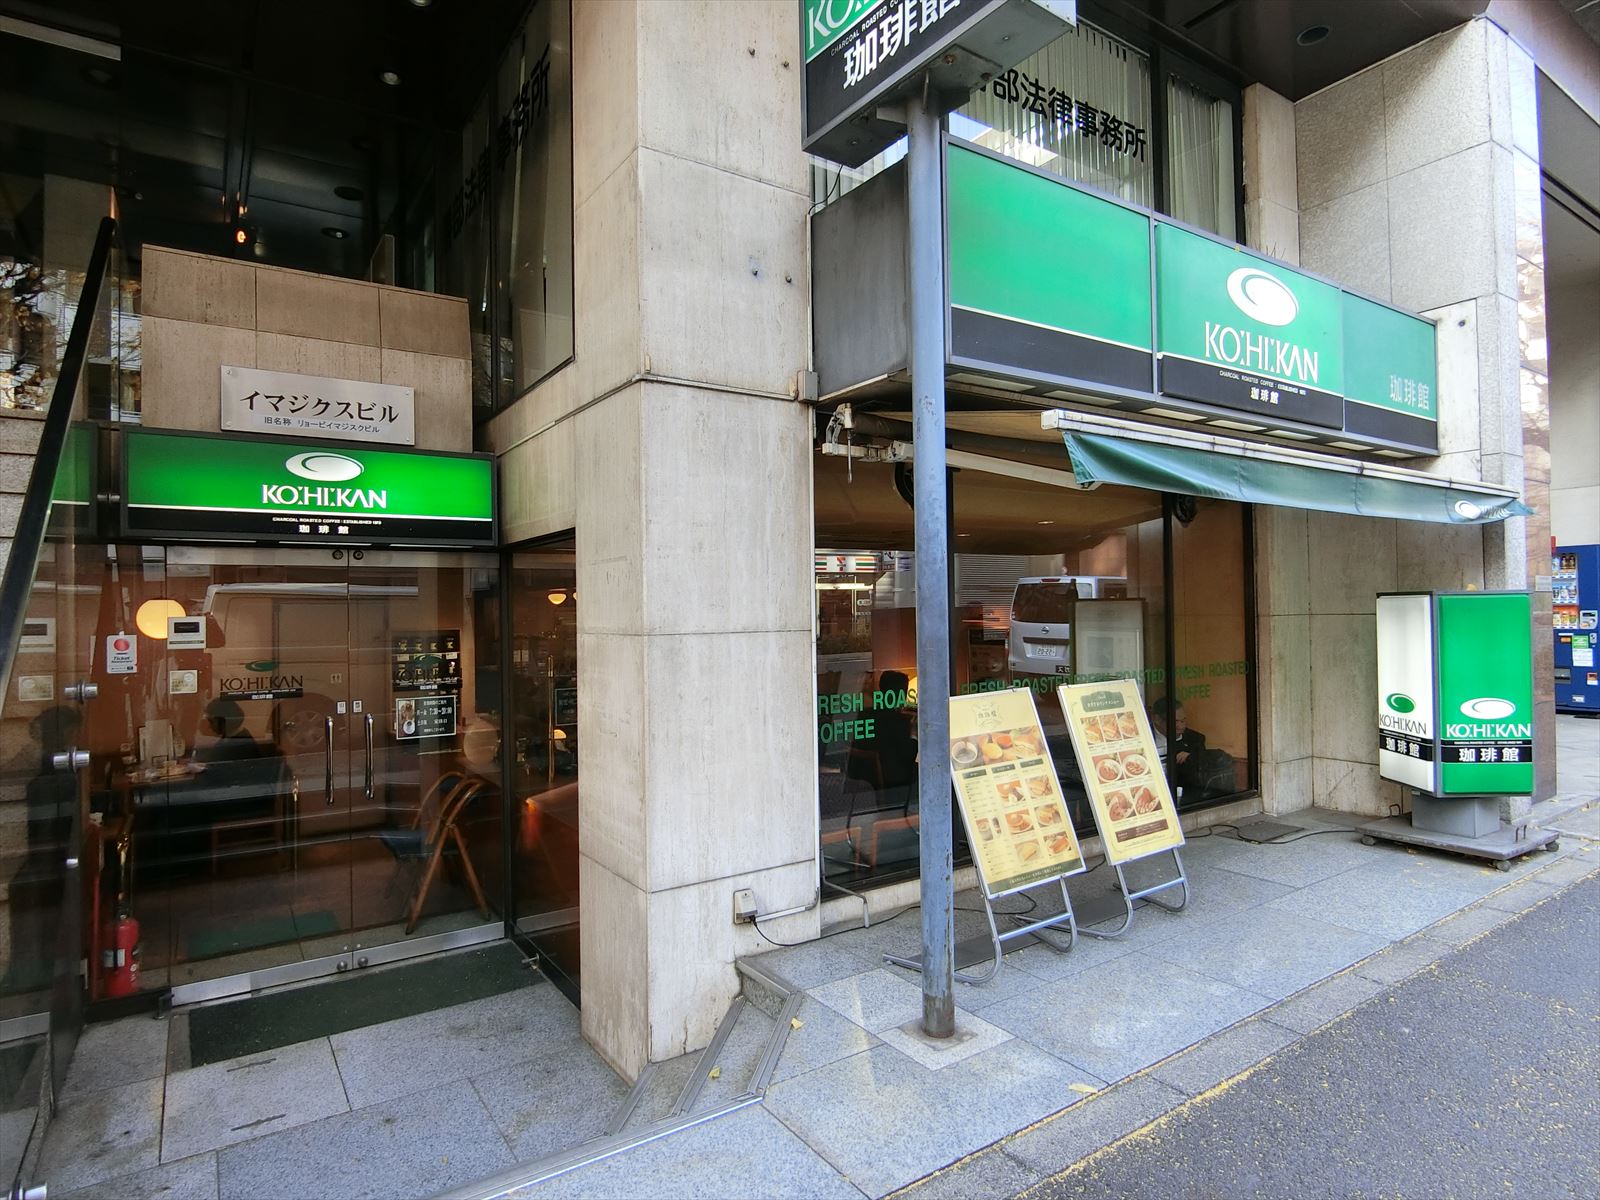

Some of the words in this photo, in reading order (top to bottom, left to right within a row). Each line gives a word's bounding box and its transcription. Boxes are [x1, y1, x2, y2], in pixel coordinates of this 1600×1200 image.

[831, 30, 860, 57] CHARCOAL
[861, 7, 888, 31] ROASTED
[980, 68, 1147, 162] 部法律事務所
[1249, 387, 1279, 404] 珈琲館
[1390, 375, 1430, 410] 珈琲館
[240, 390, 400, 424] イマジクスビル
[264, 416, 292, 426] 旧名称
[1209, 660, 1250, 677] ROASTED
[817, 719, 876, 744] OFFEE
[1385, 737, 1420, 758] 珈琲館
[1458, 747, 1520, 762] 珈琲館
